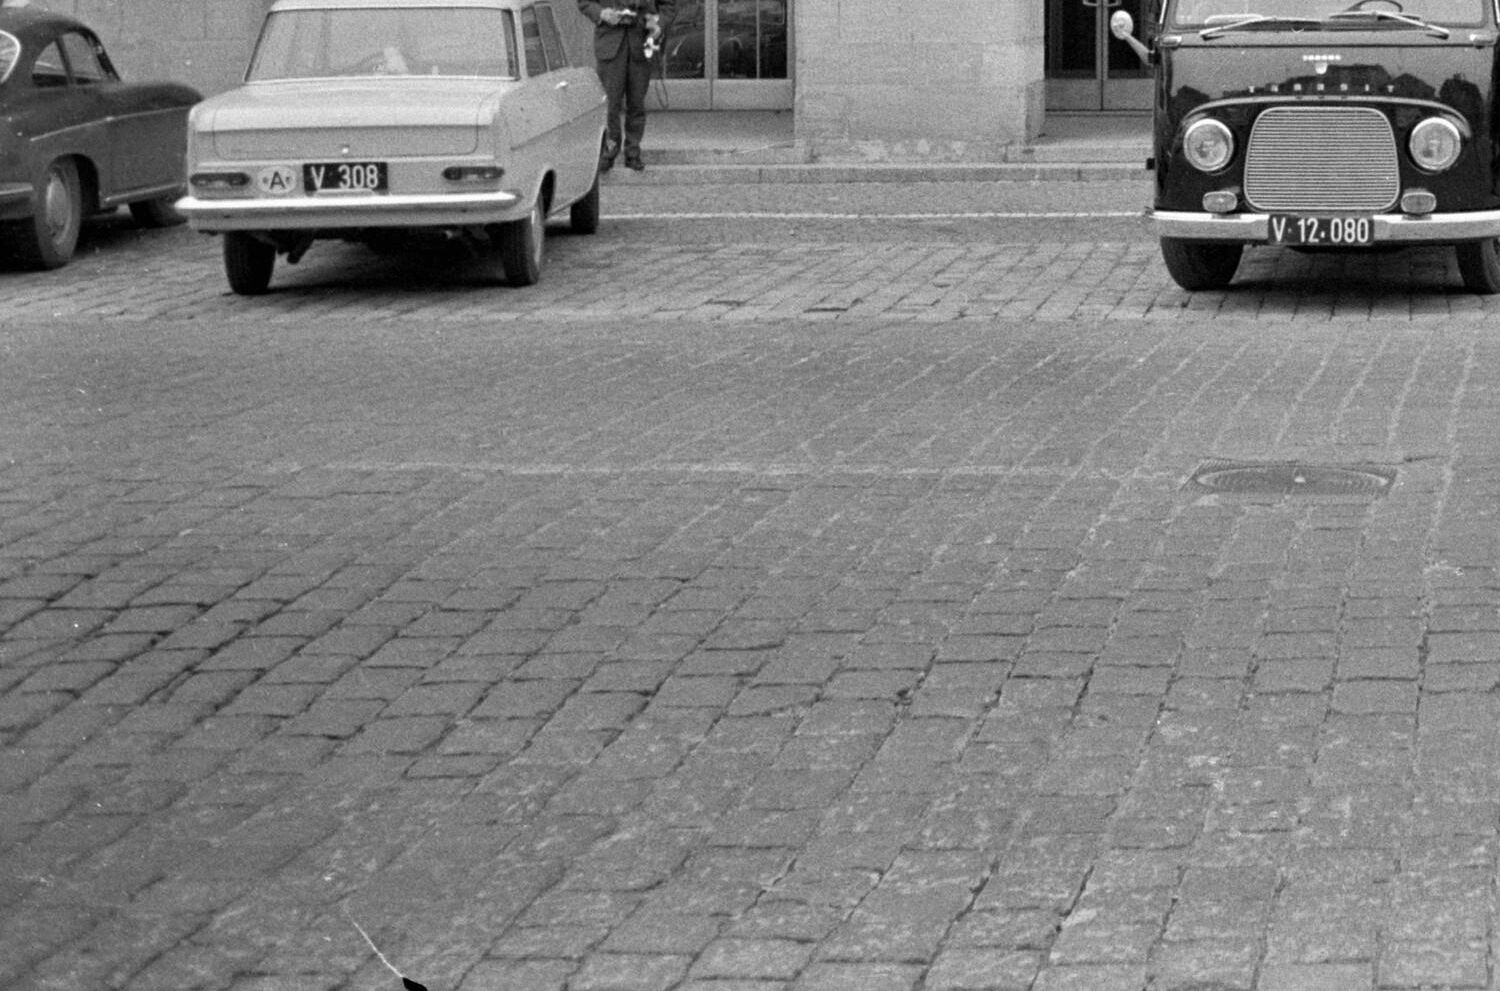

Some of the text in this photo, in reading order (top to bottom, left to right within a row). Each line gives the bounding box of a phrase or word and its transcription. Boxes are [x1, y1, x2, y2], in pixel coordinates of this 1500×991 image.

[269, 171, 286, 190] A
[310, 164, 378, 189] V 308
[1272, 216, 1369, 243] V 12.080
